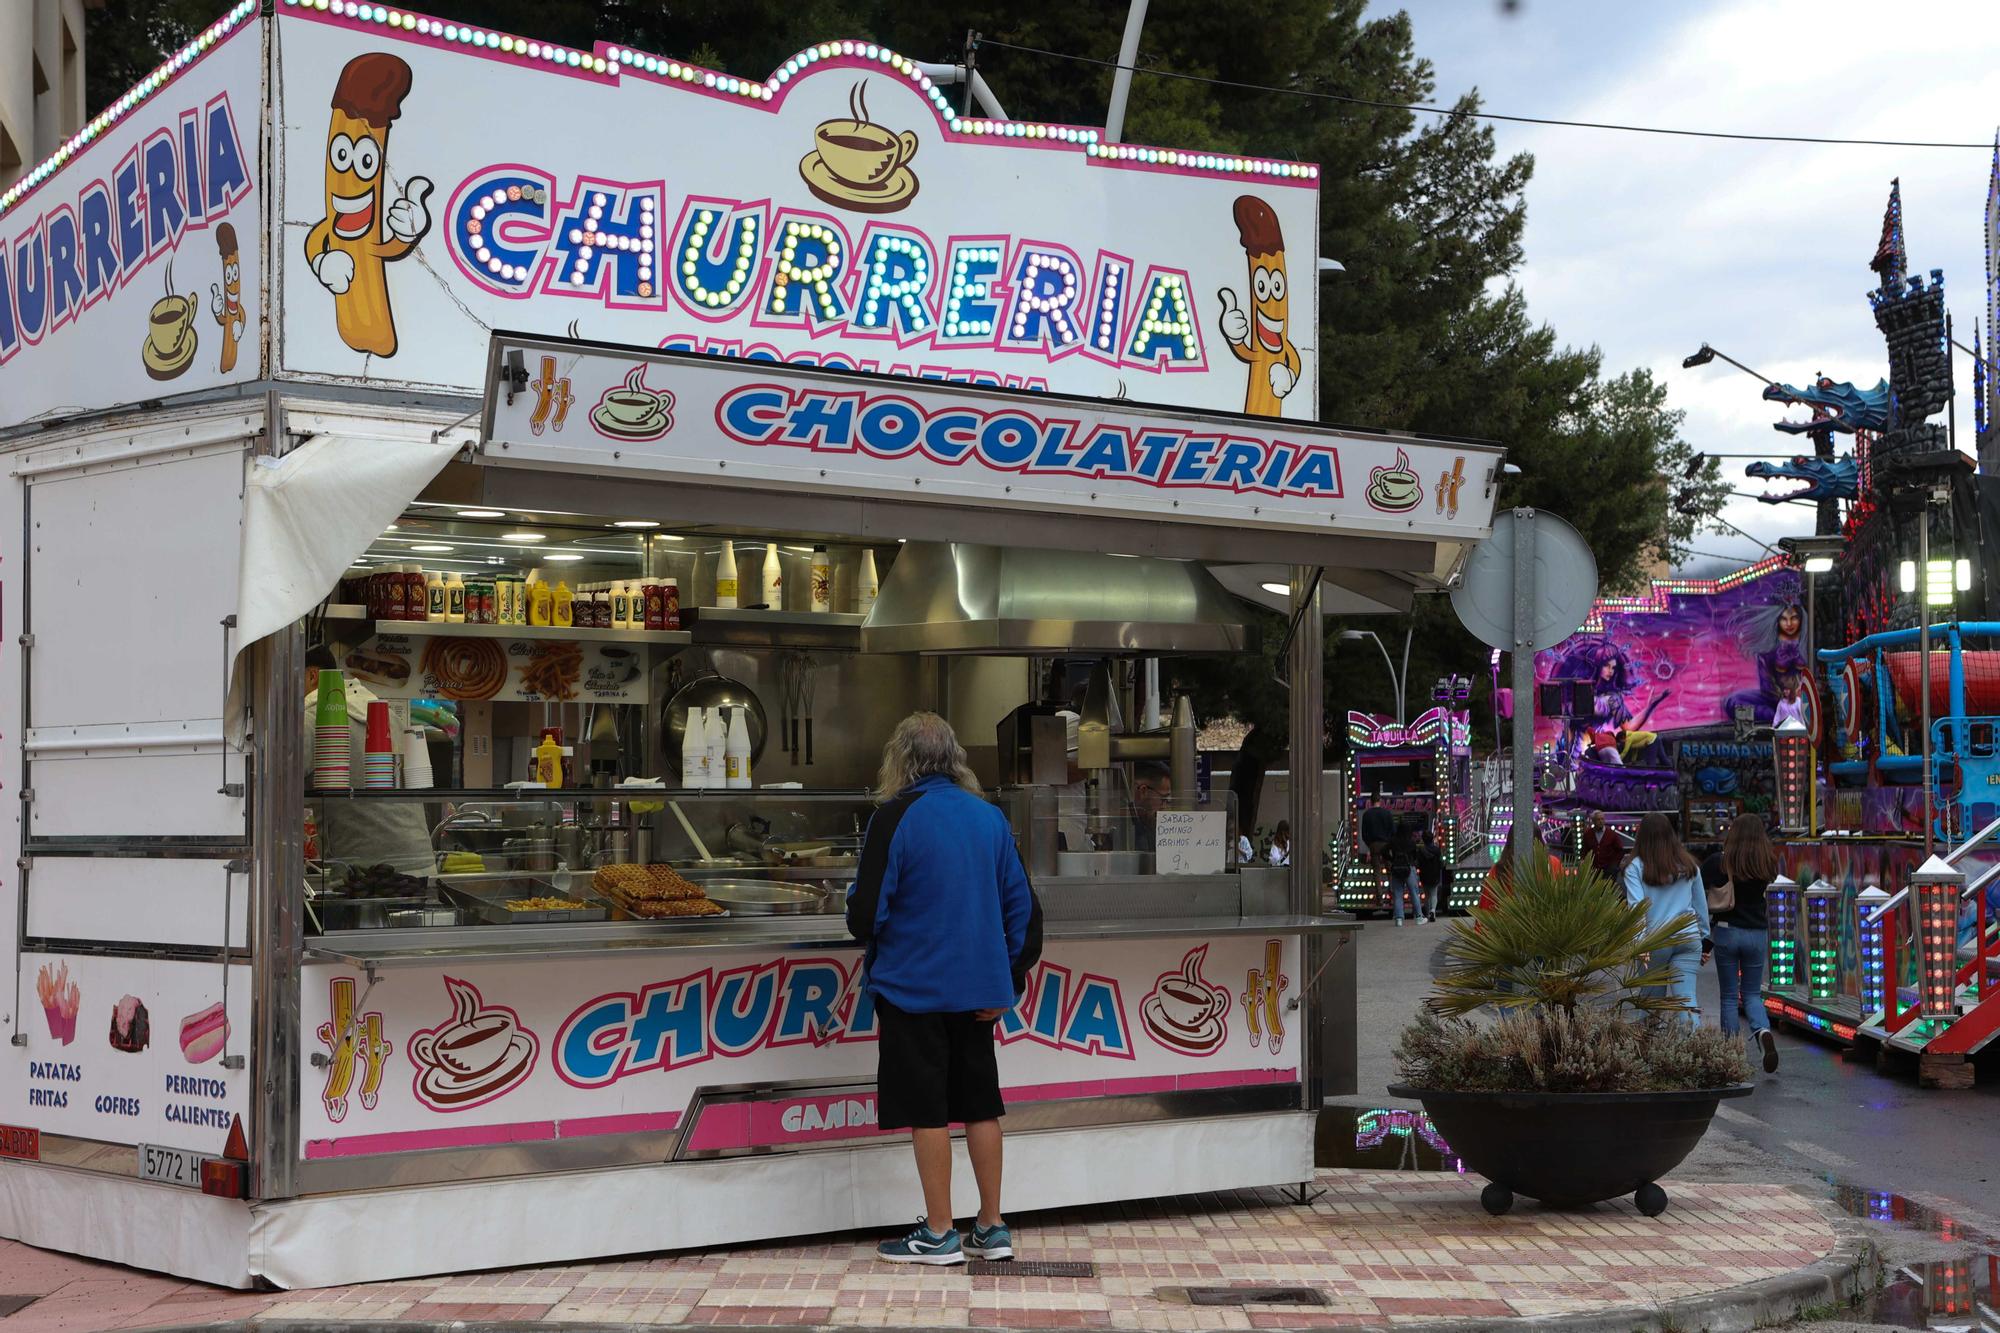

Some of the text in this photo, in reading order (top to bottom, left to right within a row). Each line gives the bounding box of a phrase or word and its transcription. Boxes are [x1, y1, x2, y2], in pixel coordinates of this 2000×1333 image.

[450, 170, 1203, 366] CHURRERIA
[721, 389, 1340, 495] CHOCOLATERIA
[1682, 744, 1751, 758] REALIDAD
[1157, 825, 1193, 836] DOMINGO
[1196, 839, 1202, 847] A
[1205, 839, 1220, 847] LAS
[558, 962, 1130, 1084] CHURIA
[29, 1061, 82, 1082] PATATAS
[29, 1088, 68, 1108] FRITAS
[165, 1074, 227, 1099] PERRITOS
[95, 1095, 140, 1117] GOFRES
[165, 1103, 231, 1130] CALIENTES
[781, 1099, 879, 1133] GANDI
[147, 1149, 205, 1184] 5772 H
